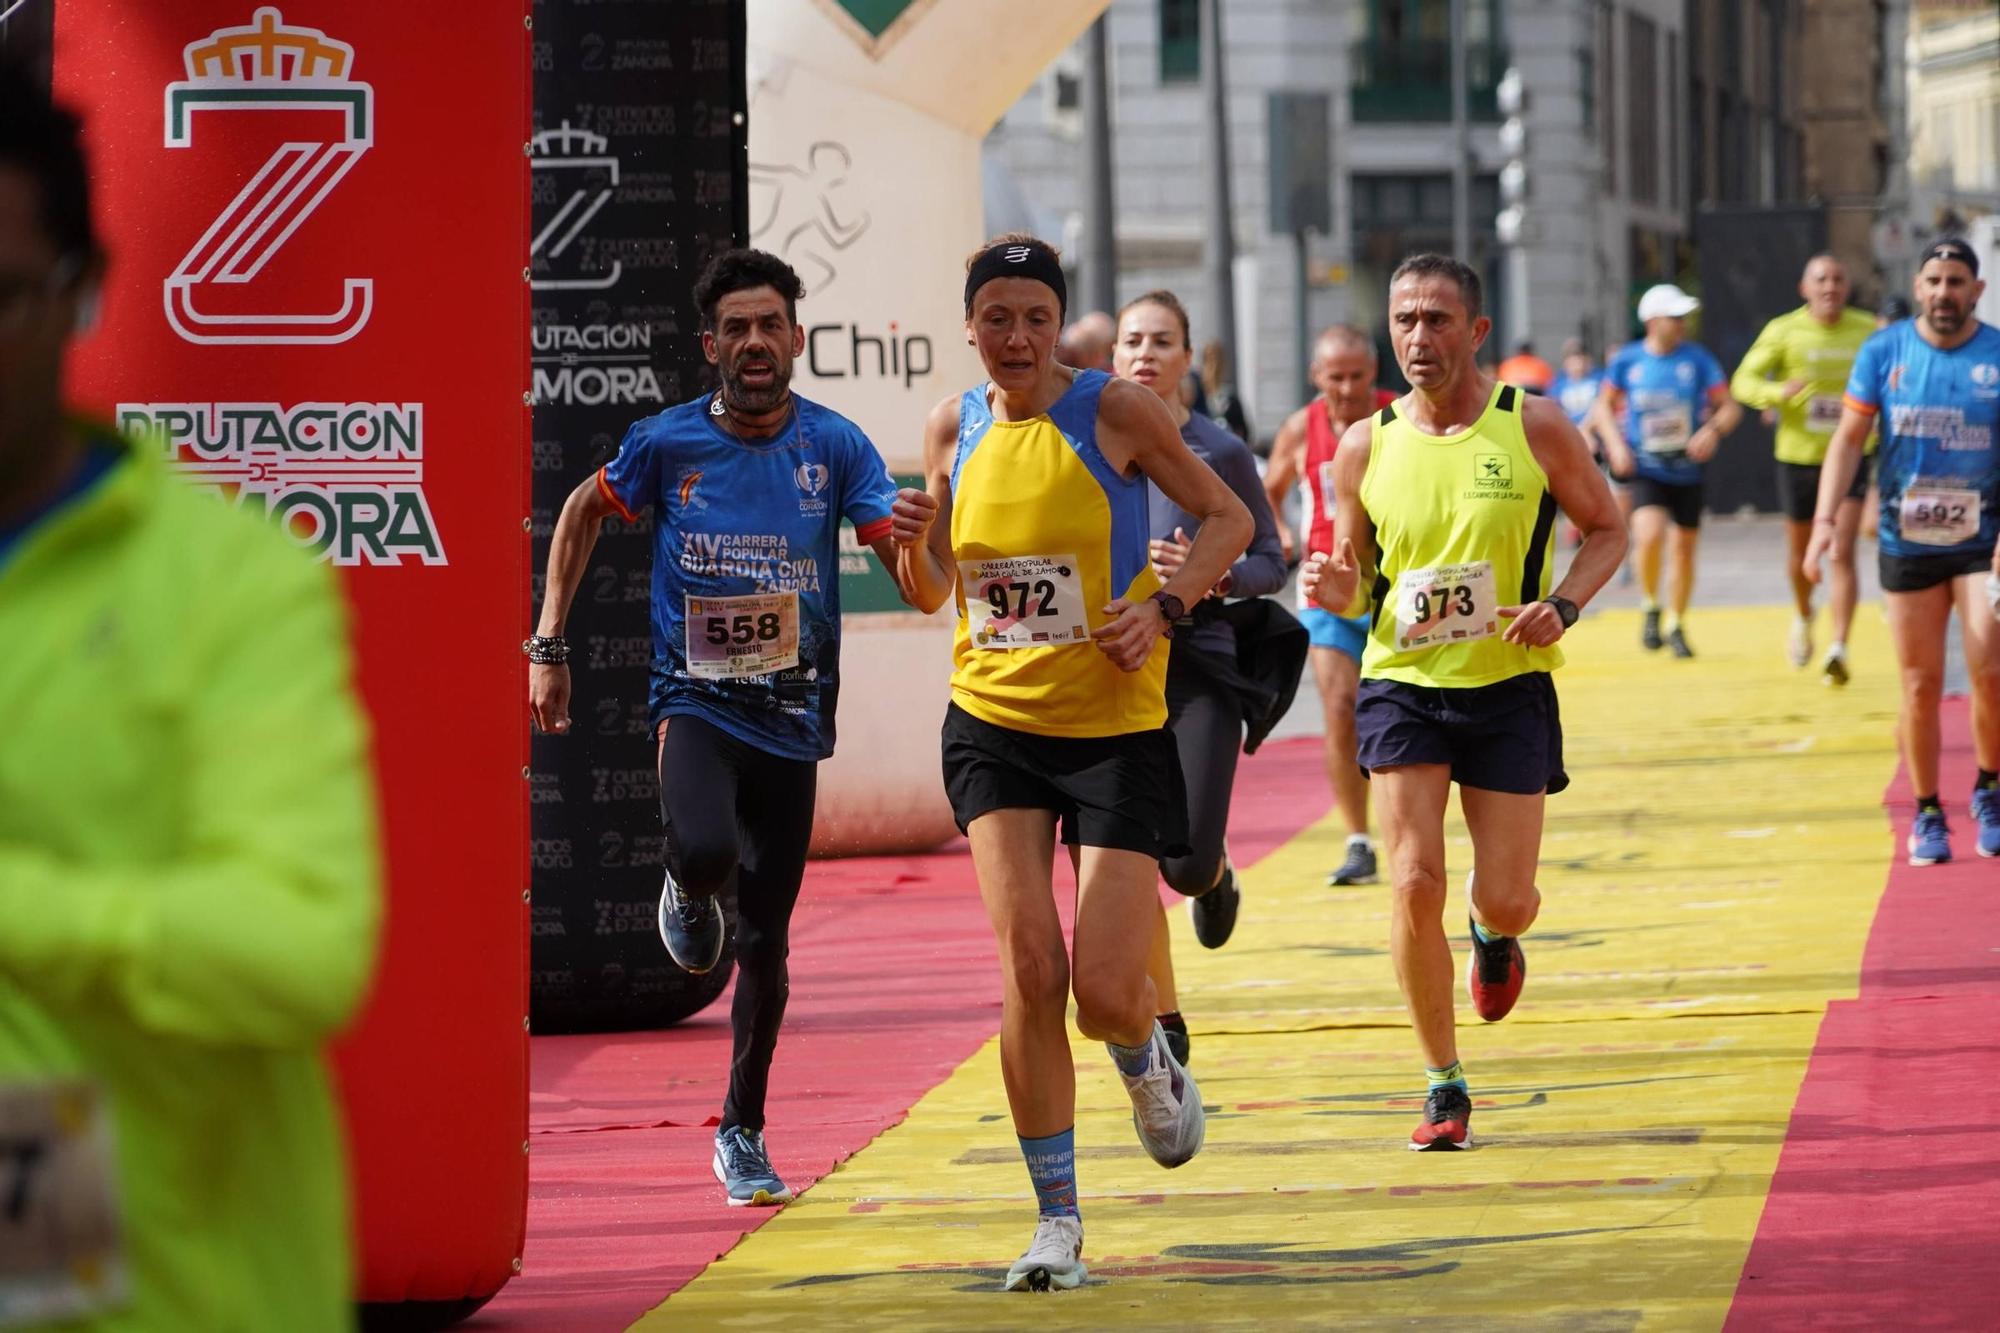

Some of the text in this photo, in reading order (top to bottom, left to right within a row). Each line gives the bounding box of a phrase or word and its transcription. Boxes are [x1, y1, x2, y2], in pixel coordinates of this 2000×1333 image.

[808, 321, 932, 388] Chip
[238, 486, 444, 564] ORA
[1915, 503, 1967, 525] 592
[680, 531, 788, 559] XIV CARRERA
[722, 547, 788, 560] POPULAR
[680, 554, 818, 579] GUARDIA CIVIL
[979, 569, 1000, 578] ARDIA
[1022, 568, 1033, 576] DE
[1035, 566, 1061, 576] ZAMO
[981, 558, 1053, 571] CARRERA POPULAR
[754, 578, 820, 599] ZAMORA
[987, 579, 1059, 620] 972
[1415, 585, 1475, 624] 973
[705, 612, 781, 645] 558
[726, 644, 762, 656] ERNESTO
